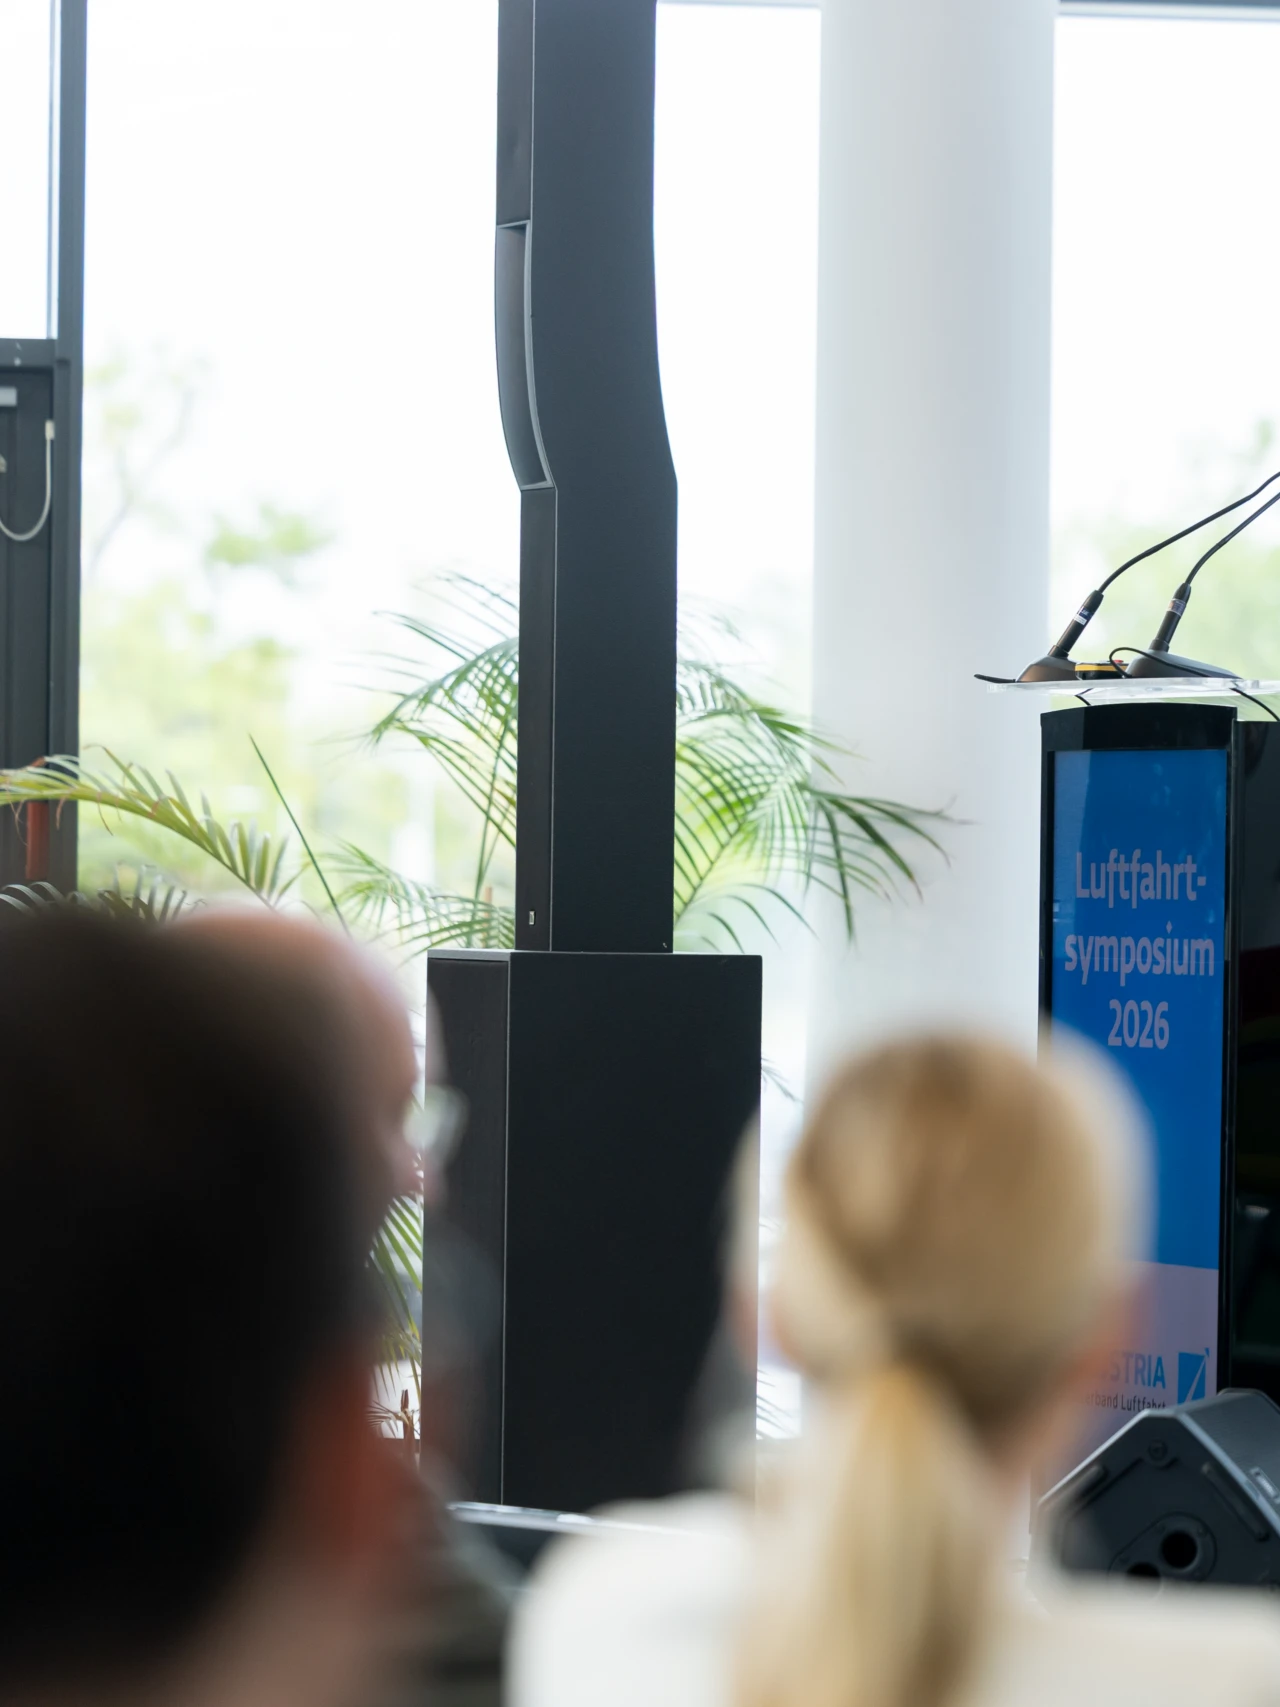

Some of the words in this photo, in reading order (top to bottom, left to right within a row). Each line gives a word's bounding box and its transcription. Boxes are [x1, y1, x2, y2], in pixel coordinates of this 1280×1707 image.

[1076, 848, 1206, 909] Luftfahrt-
[1065, 920, 1214, 986] symposium
[1107, 999, 1169, 1049] 2026
[1100, 1351, 1166, 1389] STRIA
[1084, 1392, 1118, 1409] erband
